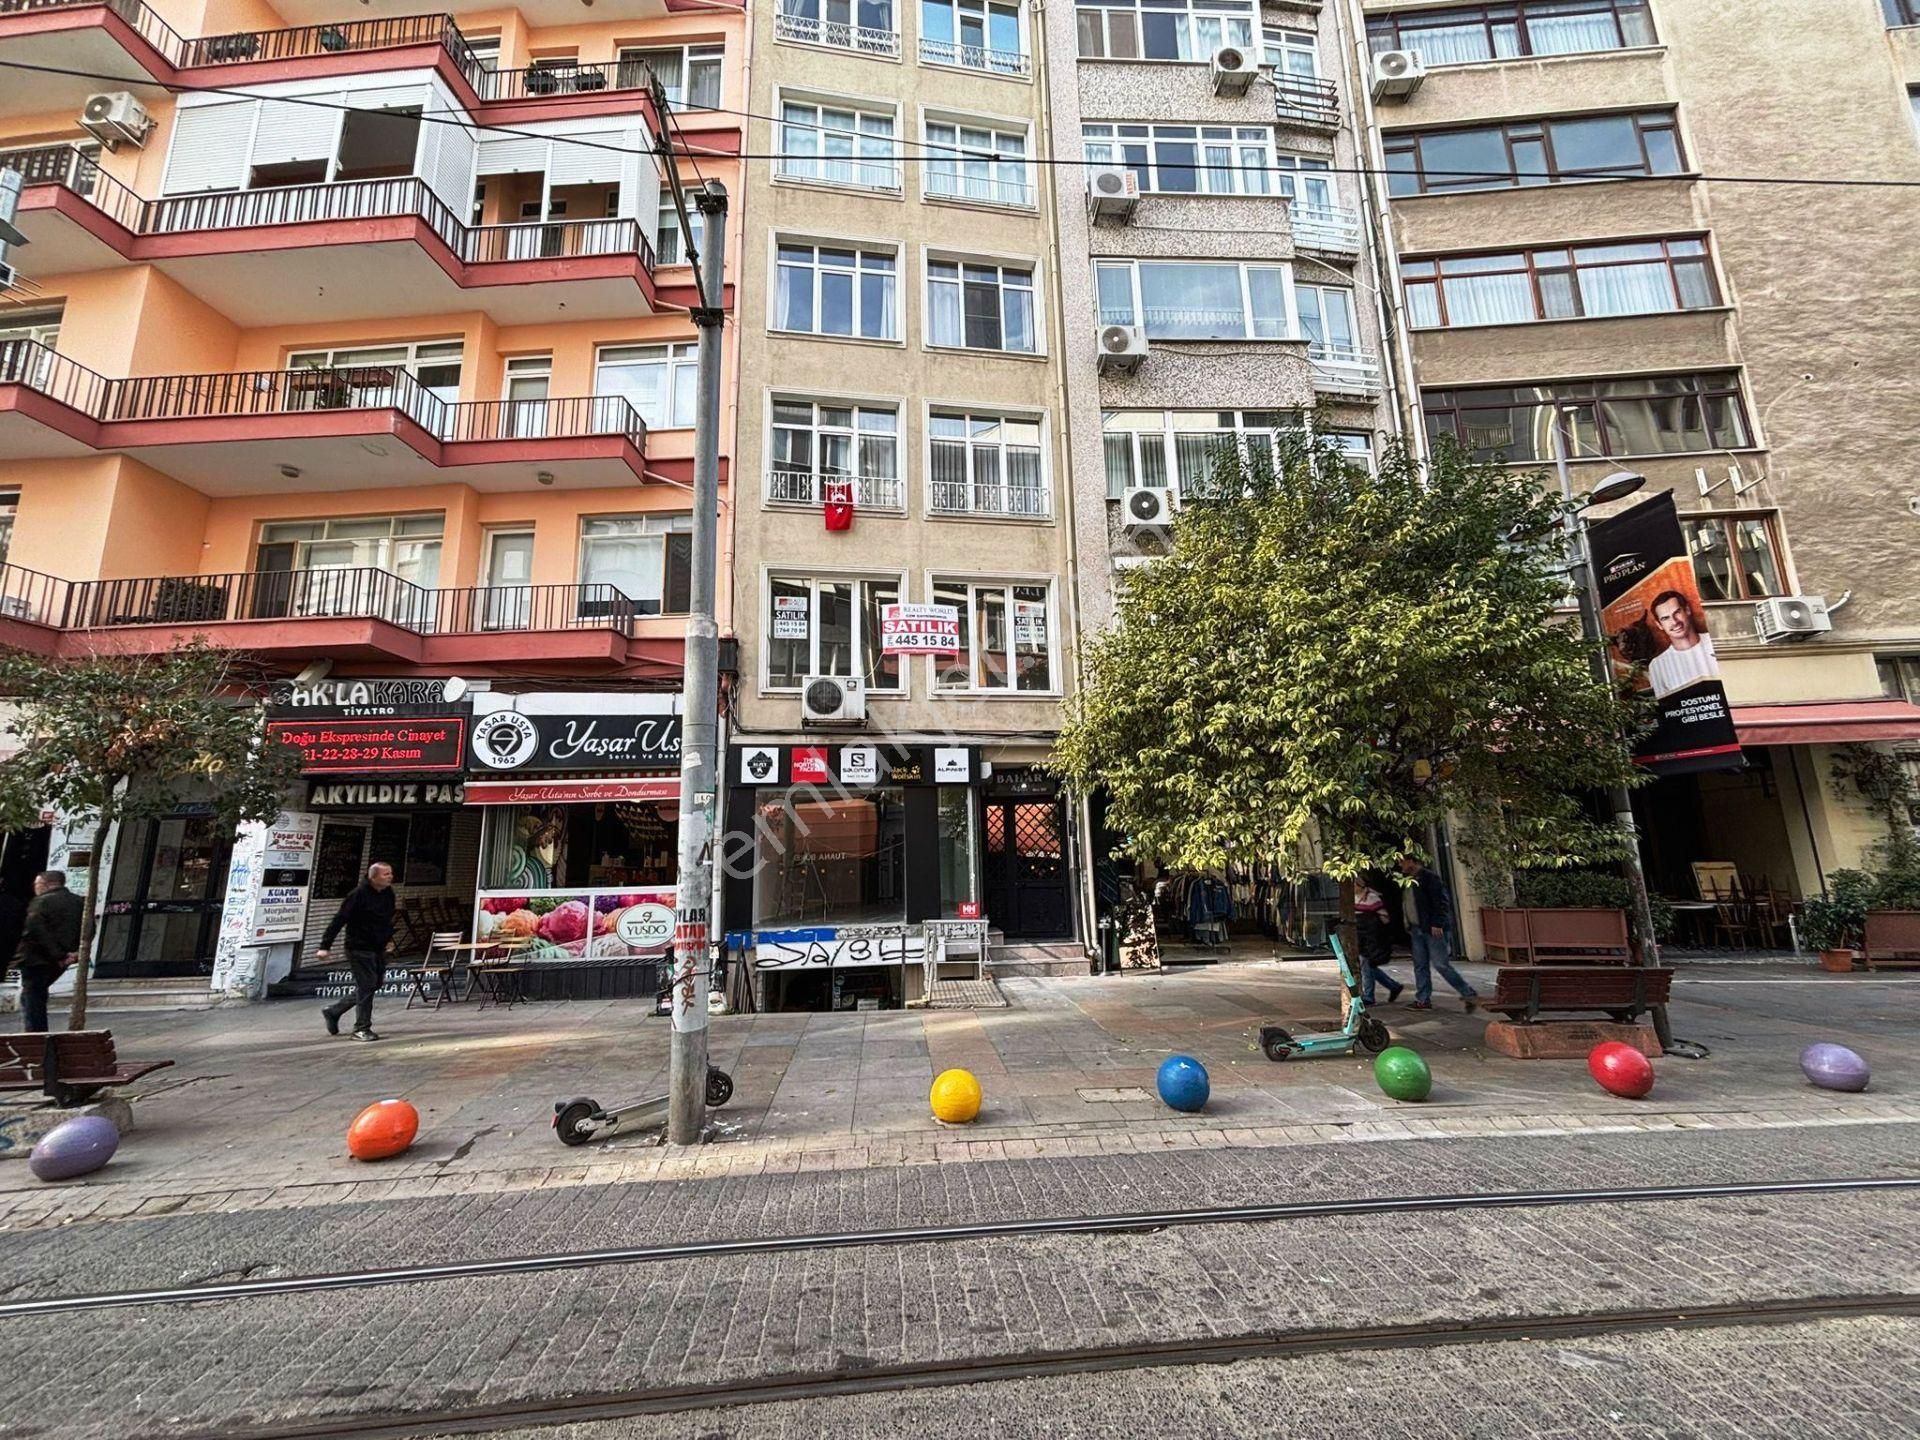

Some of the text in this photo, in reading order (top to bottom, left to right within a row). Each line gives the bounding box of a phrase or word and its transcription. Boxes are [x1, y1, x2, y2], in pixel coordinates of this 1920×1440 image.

[1621, 561, 1647, 578] PLAN
[775, 611, 806, 621] SATILIK
[884, 620, 957, 635] SATILIK
[895, 635, 919, 647] 445
[922, 635, 938, 647] 15
[940, 636, 956, 648] 84
[373, 680, 446, 705] KARA
[1680, 693, 1721, 707] DOSTUNU
[342, 706, 396, 717] TİYATRO
[1664, 702, 1724, 719] PROFESYONEL
[1698, 709, 1726, 721] BESLE
[510, 715, 533, 740] USTA
[281, 728, 447, 747] Doğu Ekspresinde Cinayet
[549, 720, 637, 760] Yaşar
[381, 746, 422, 760] Kasım
[492, 756, 516, 764] 1962
[310, 784, 419, 805] AKYILDIZ
[508, 787, 539, 801] Yaşar
[626, 924, 668, 936] YUSDO
